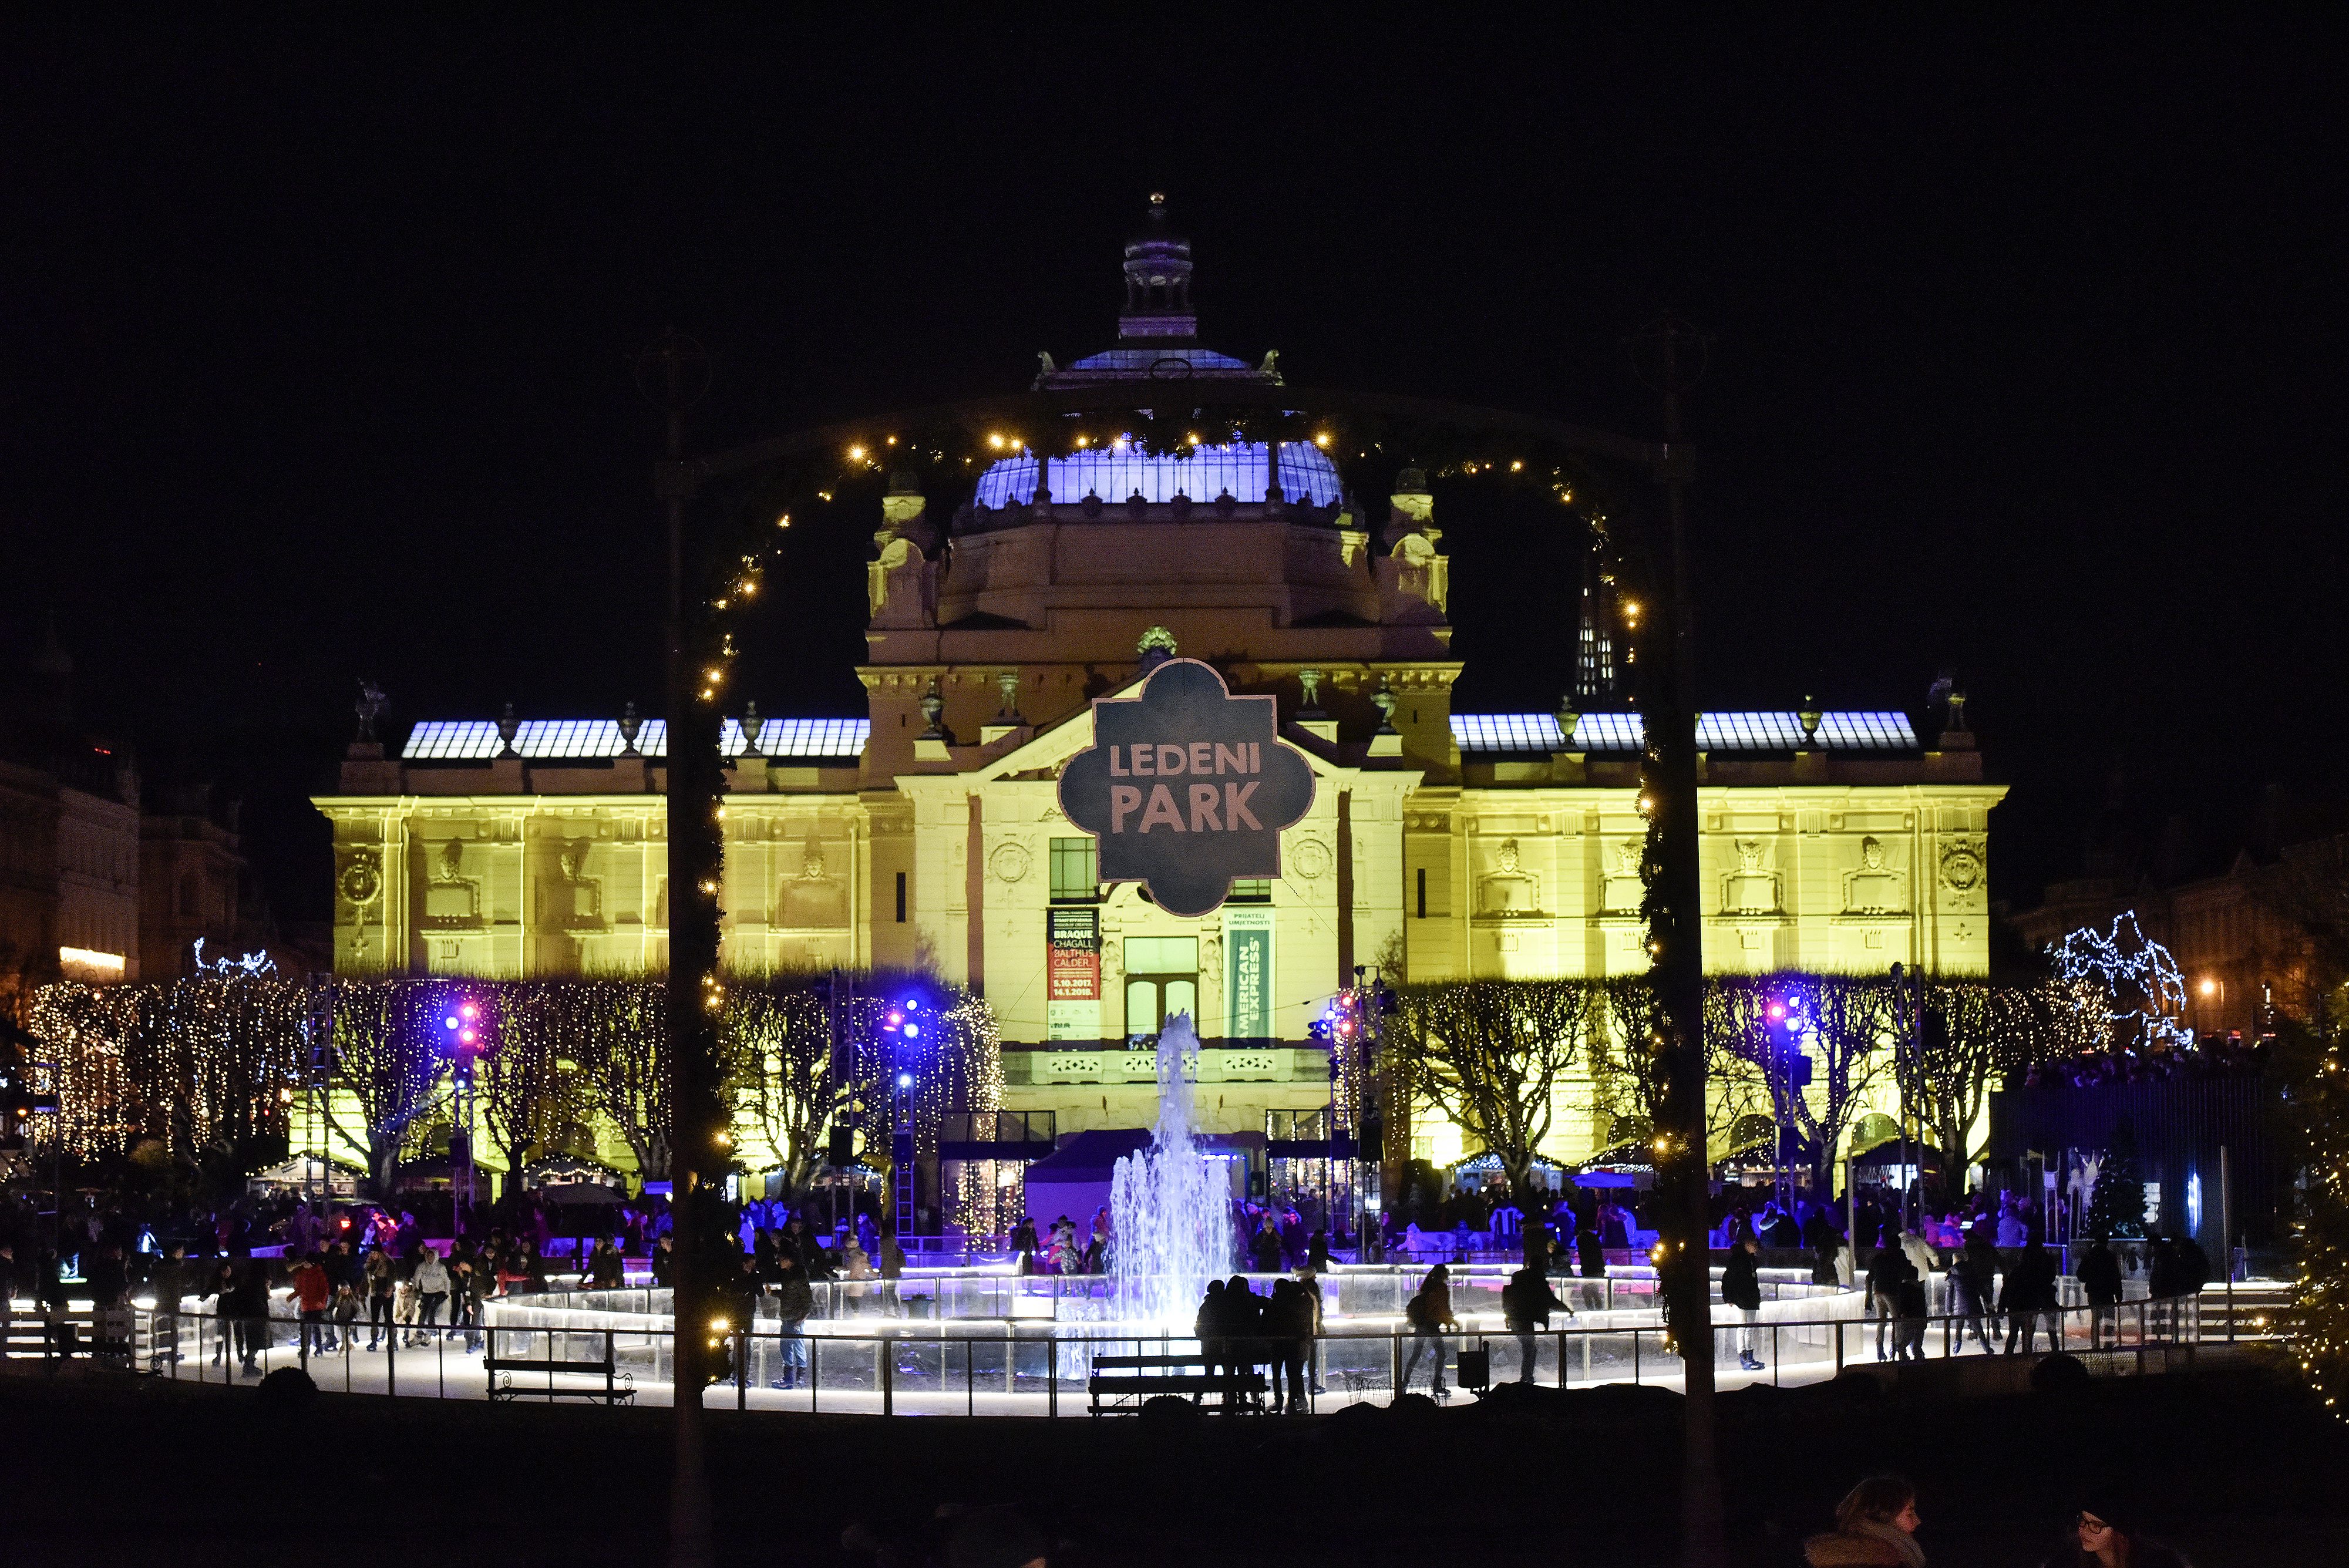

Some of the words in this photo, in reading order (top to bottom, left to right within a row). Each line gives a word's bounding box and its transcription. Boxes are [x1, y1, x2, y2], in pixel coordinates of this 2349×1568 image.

[1110, 742, 1260, 776] LEDENI
[1111, 781, 1263, 833] PARK
[1054, 930, 1093, 939] BRAQUE
[1054, 940, 1093, 948] CHAGALL
[1054, 949, 1094, 958] BALTHUS
